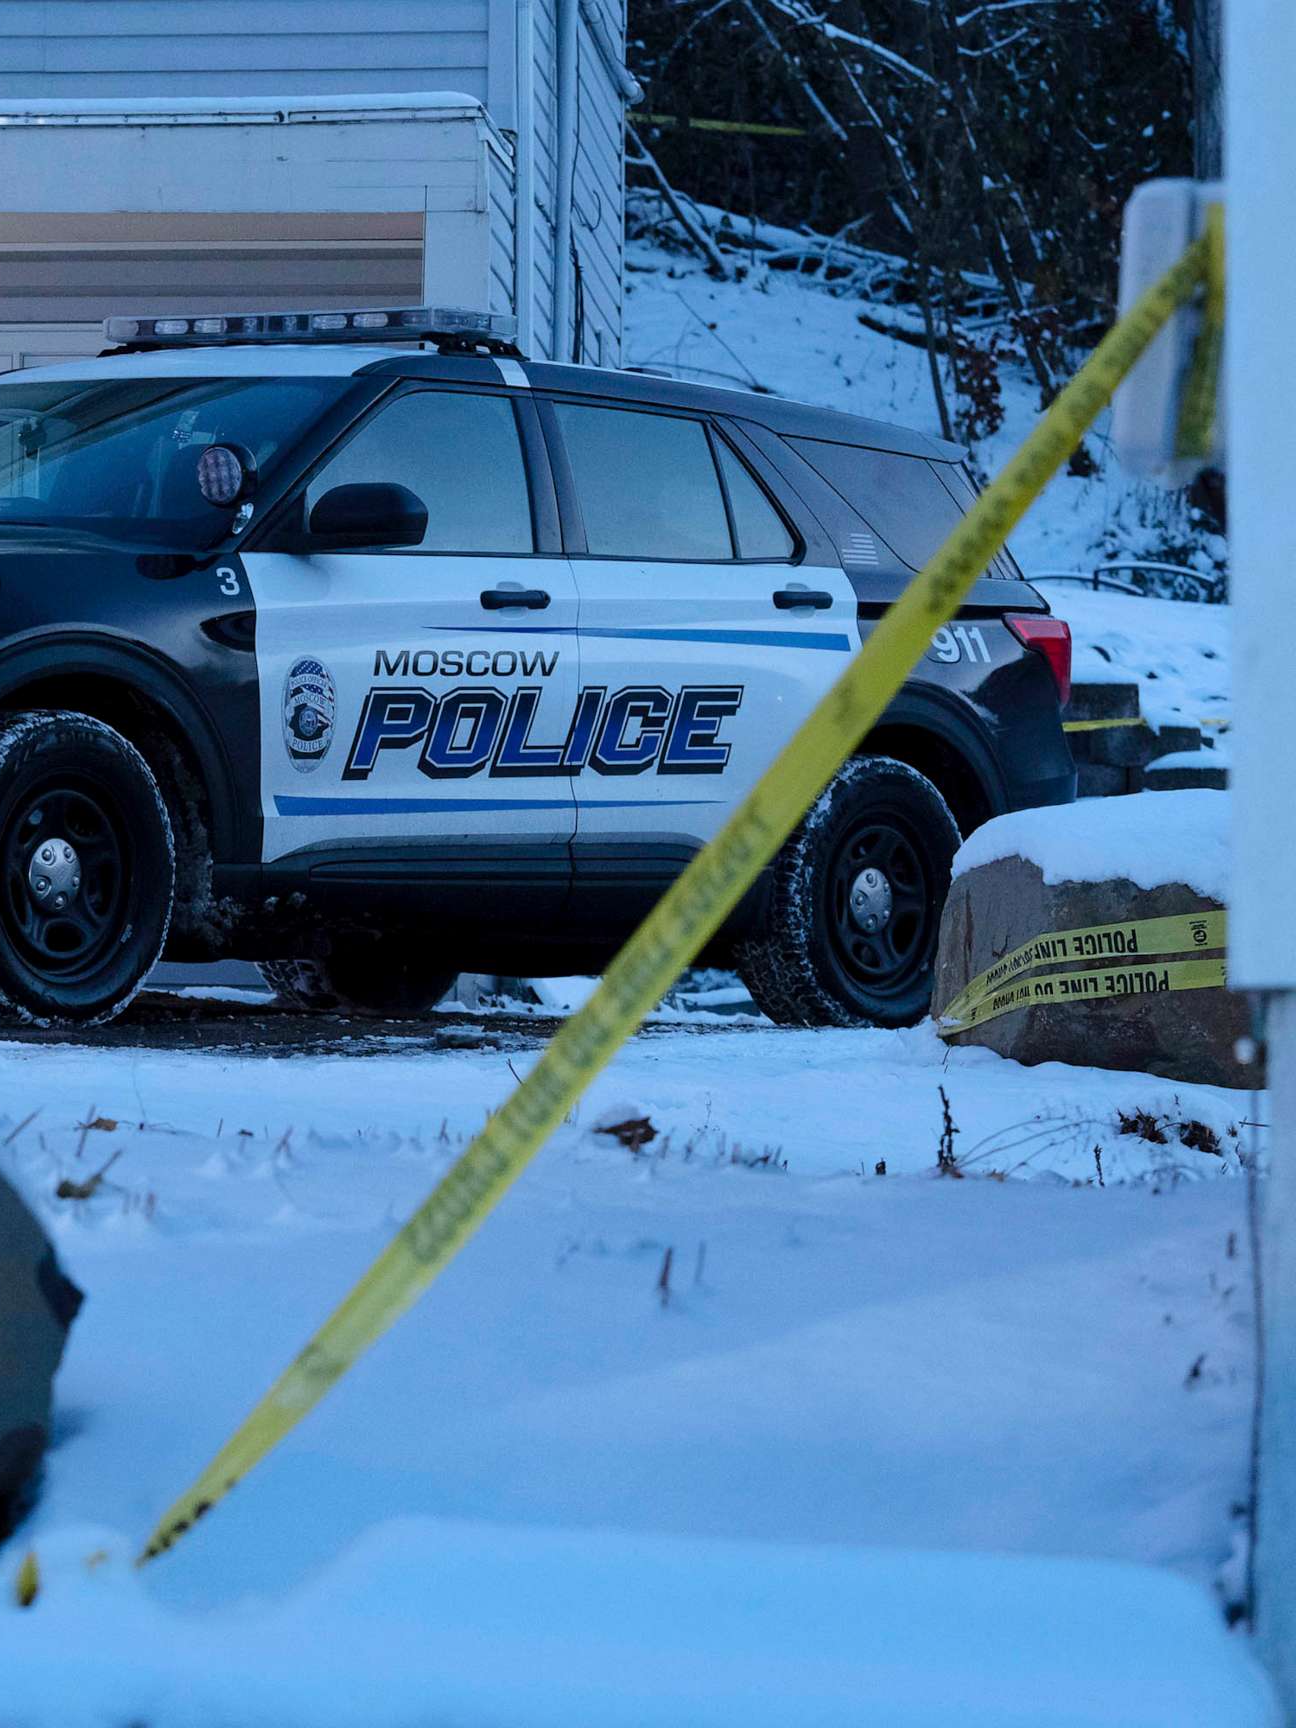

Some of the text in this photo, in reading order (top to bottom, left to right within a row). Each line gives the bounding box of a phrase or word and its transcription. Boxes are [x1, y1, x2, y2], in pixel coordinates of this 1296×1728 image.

[216, 567, 240, 596] 3
[930, 626, 992, 663] 911
[373, 650, 560, 677] MOSCOW
[292, 739, 324, 752] POLICE
[341, 685, 745, 781] POLICE
[1073, 929, 1138, 956] POLICE
[1060, 977, 1098, 994] LINE
[1105, 970, 1169, 993] POLICE
